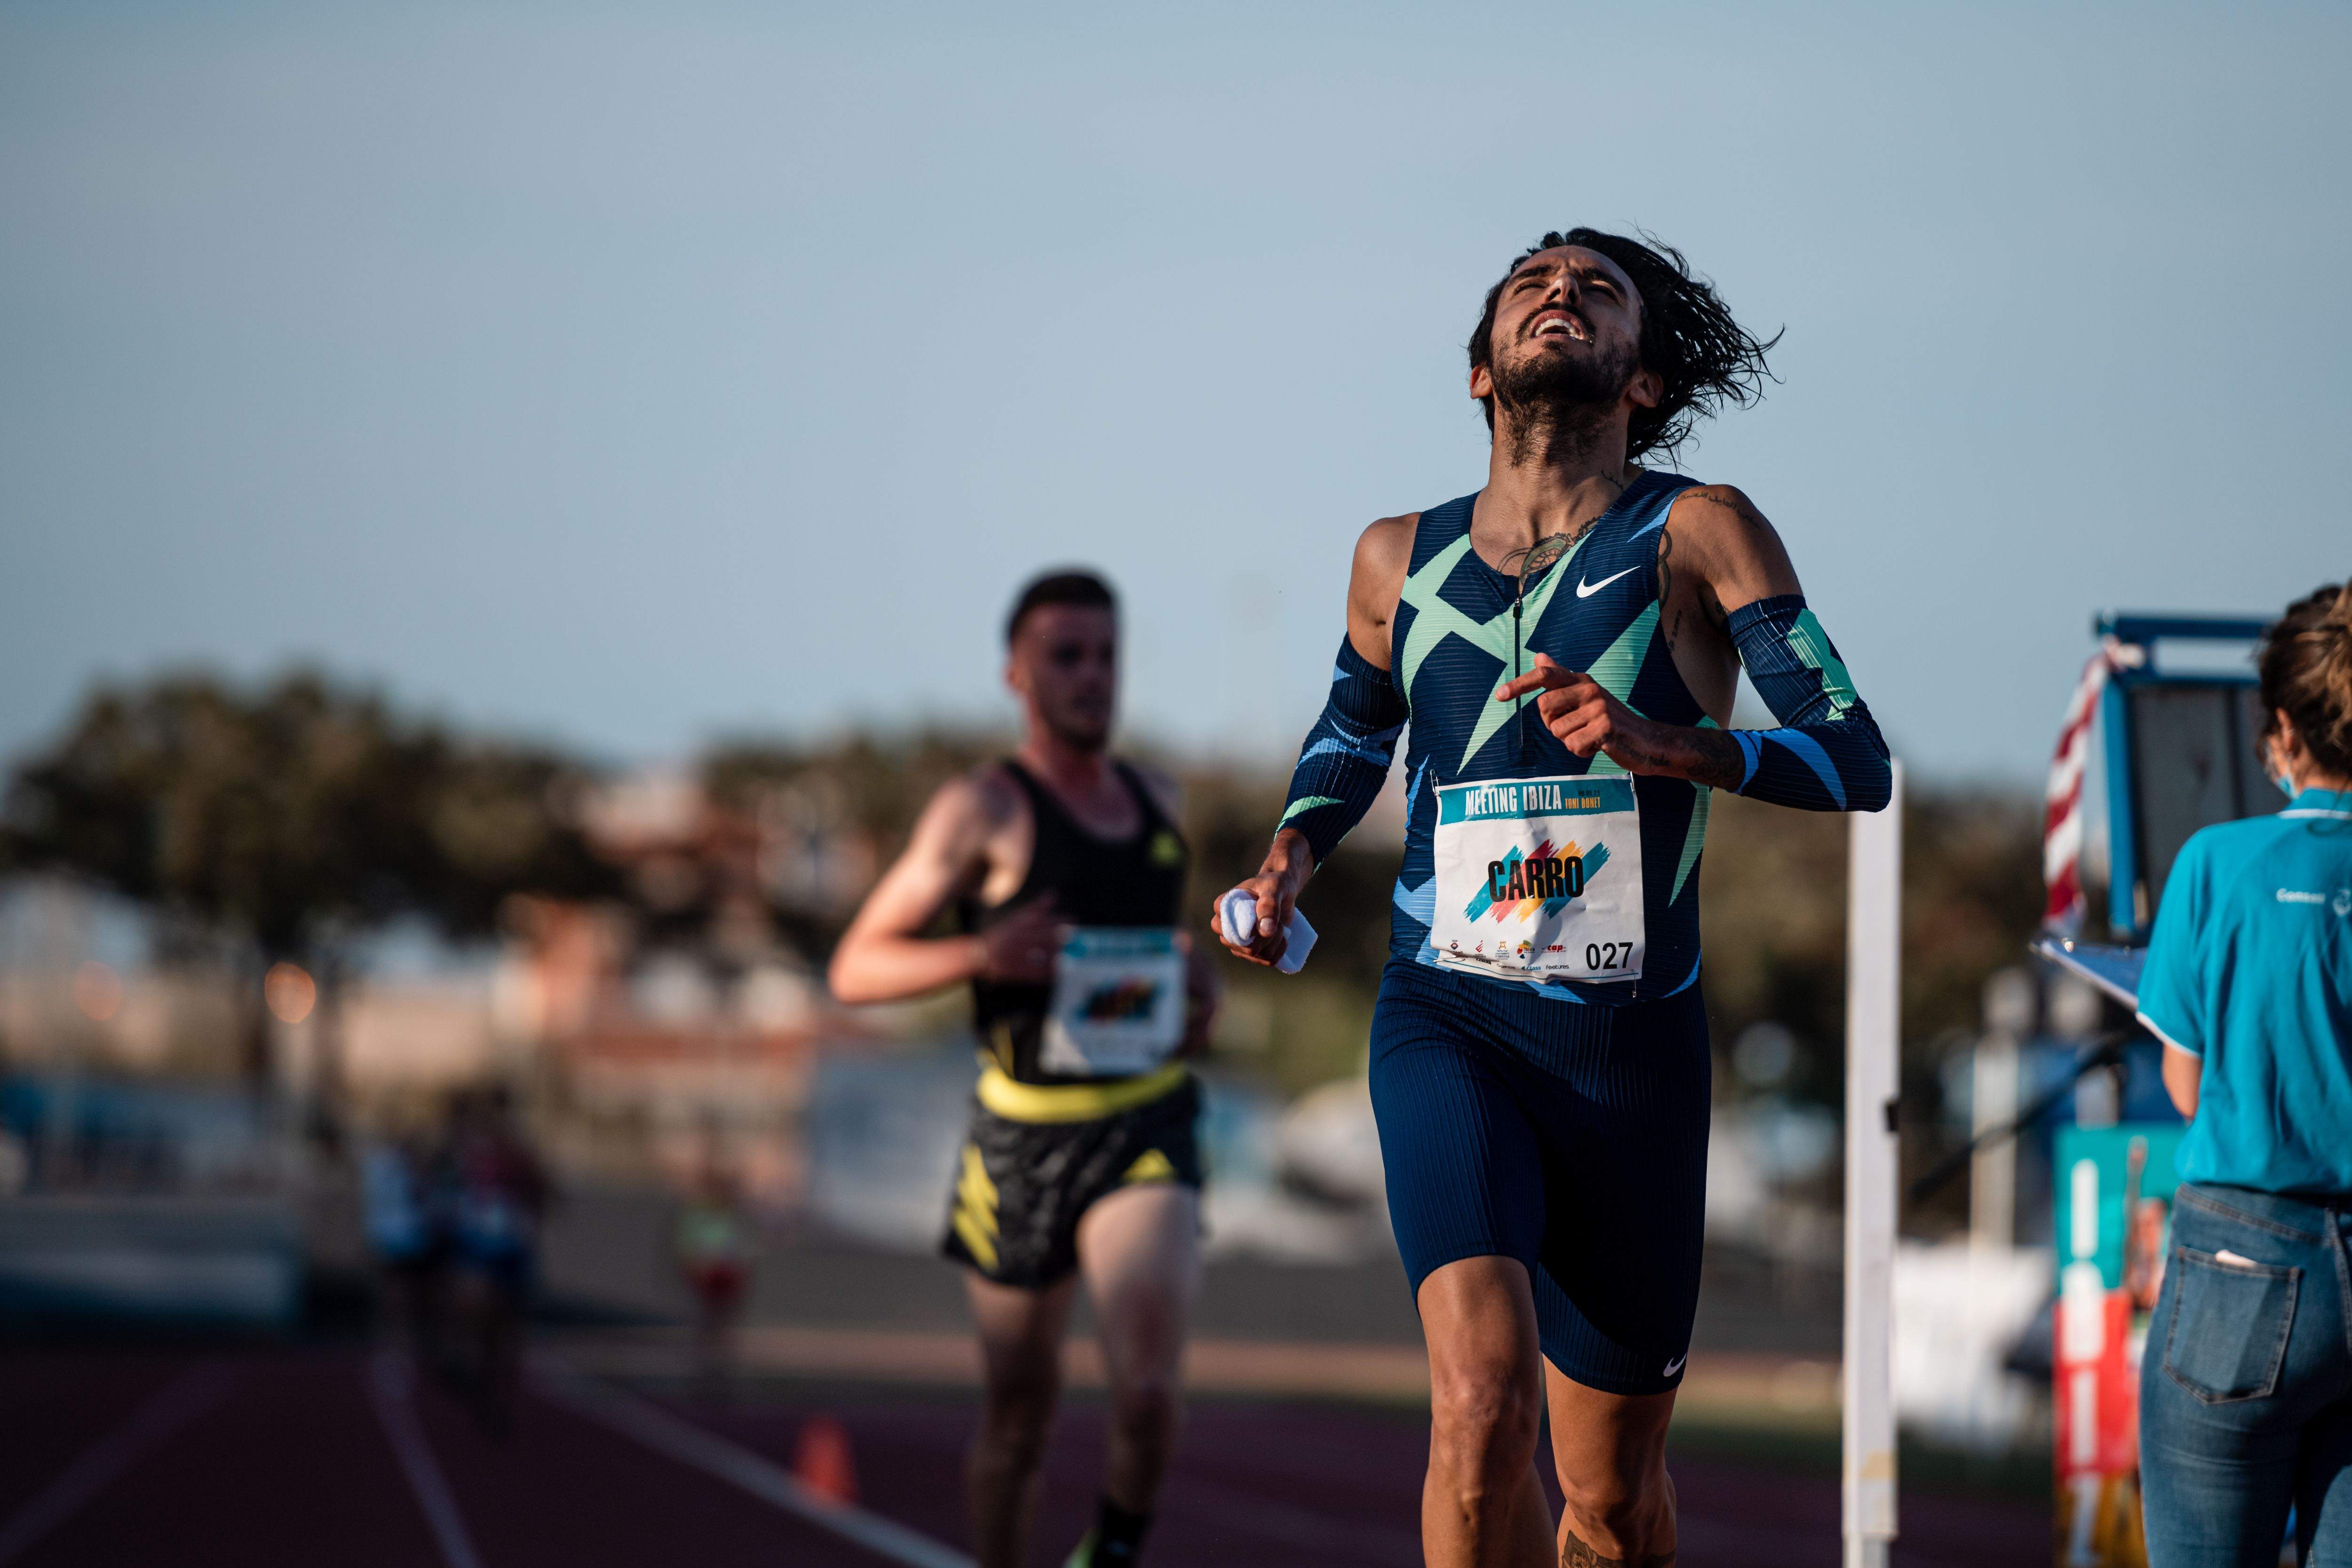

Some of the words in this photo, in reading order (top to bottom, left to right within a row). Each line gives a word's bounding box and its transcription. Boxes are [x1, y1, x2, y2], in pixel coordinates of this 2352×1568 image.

[1465, 786, 1518, 816] MEETING
[1522, 785, 1562, 811] IBIZA
[1565, 797, 1580, 809] TONI
[1581, 796, 1600, 809] BONET
[1487, 856, 1584, 902] CARRO
[1586, 942, 1633, 971] 027
